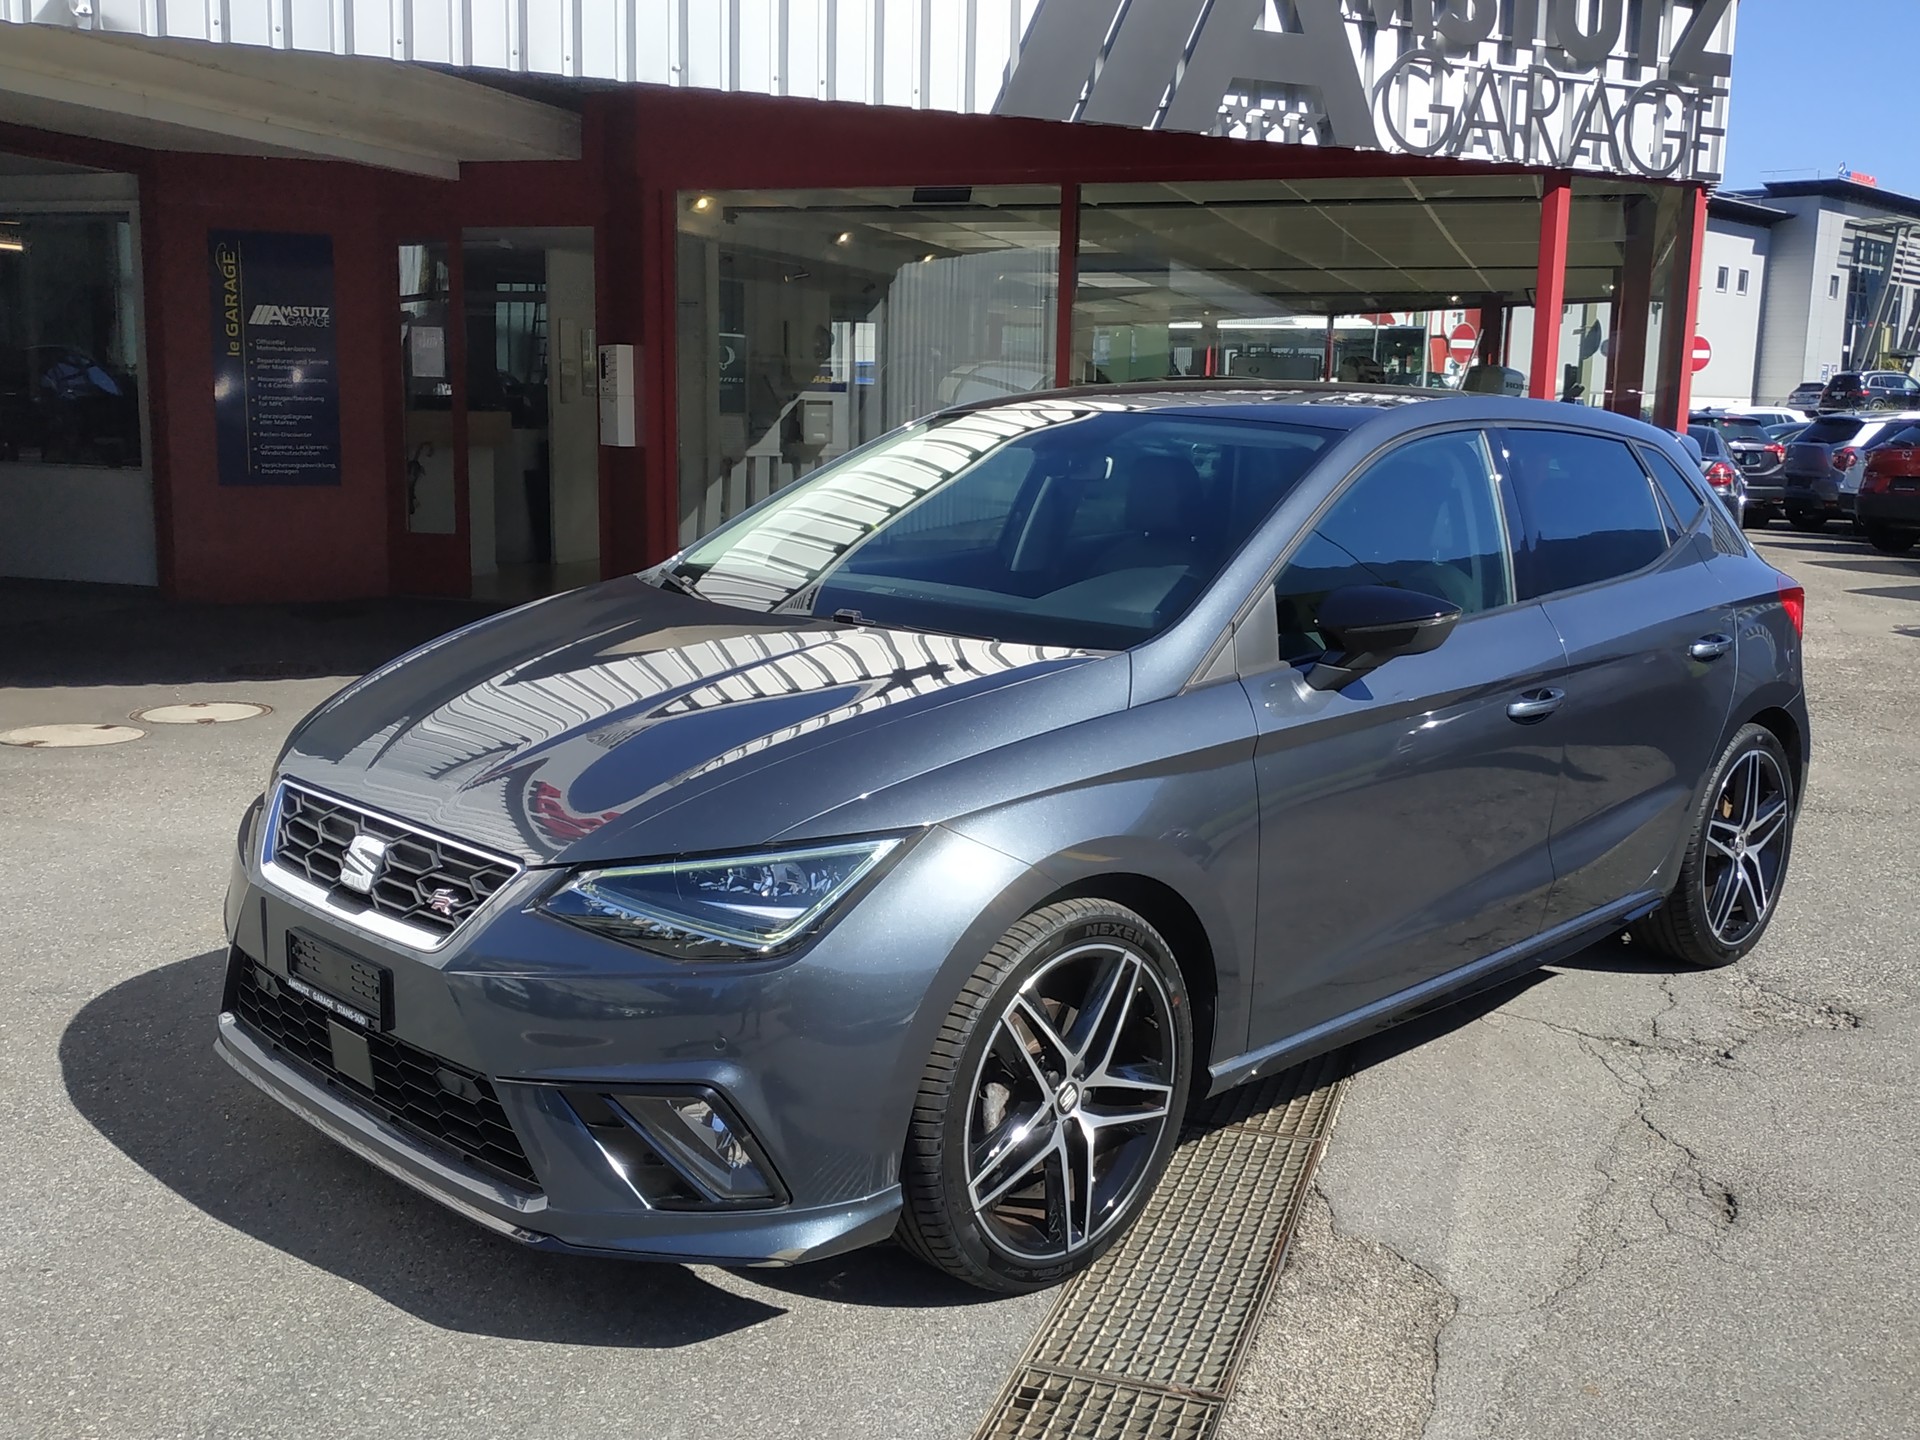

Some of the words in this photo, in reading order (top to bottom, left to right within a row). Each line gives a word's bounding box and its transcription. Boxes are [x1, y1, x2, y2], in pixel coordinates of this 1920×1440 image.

[1381, 49, 1729, 179] GARAGE
[222, 250, 239, 337] GARAGE
[264, 304, 330, 326] AMSTUTZ
[286, 316, 330, 328] GARAGE
[226, 341, 240, 357] le
[1505, 381, 1532, 391] HOND
[1084, 923, 1146, 945] NEXEN
[287, 977, 310, 997] AMSTUTZ
[312, 991, 334, 1010] GARAGE
